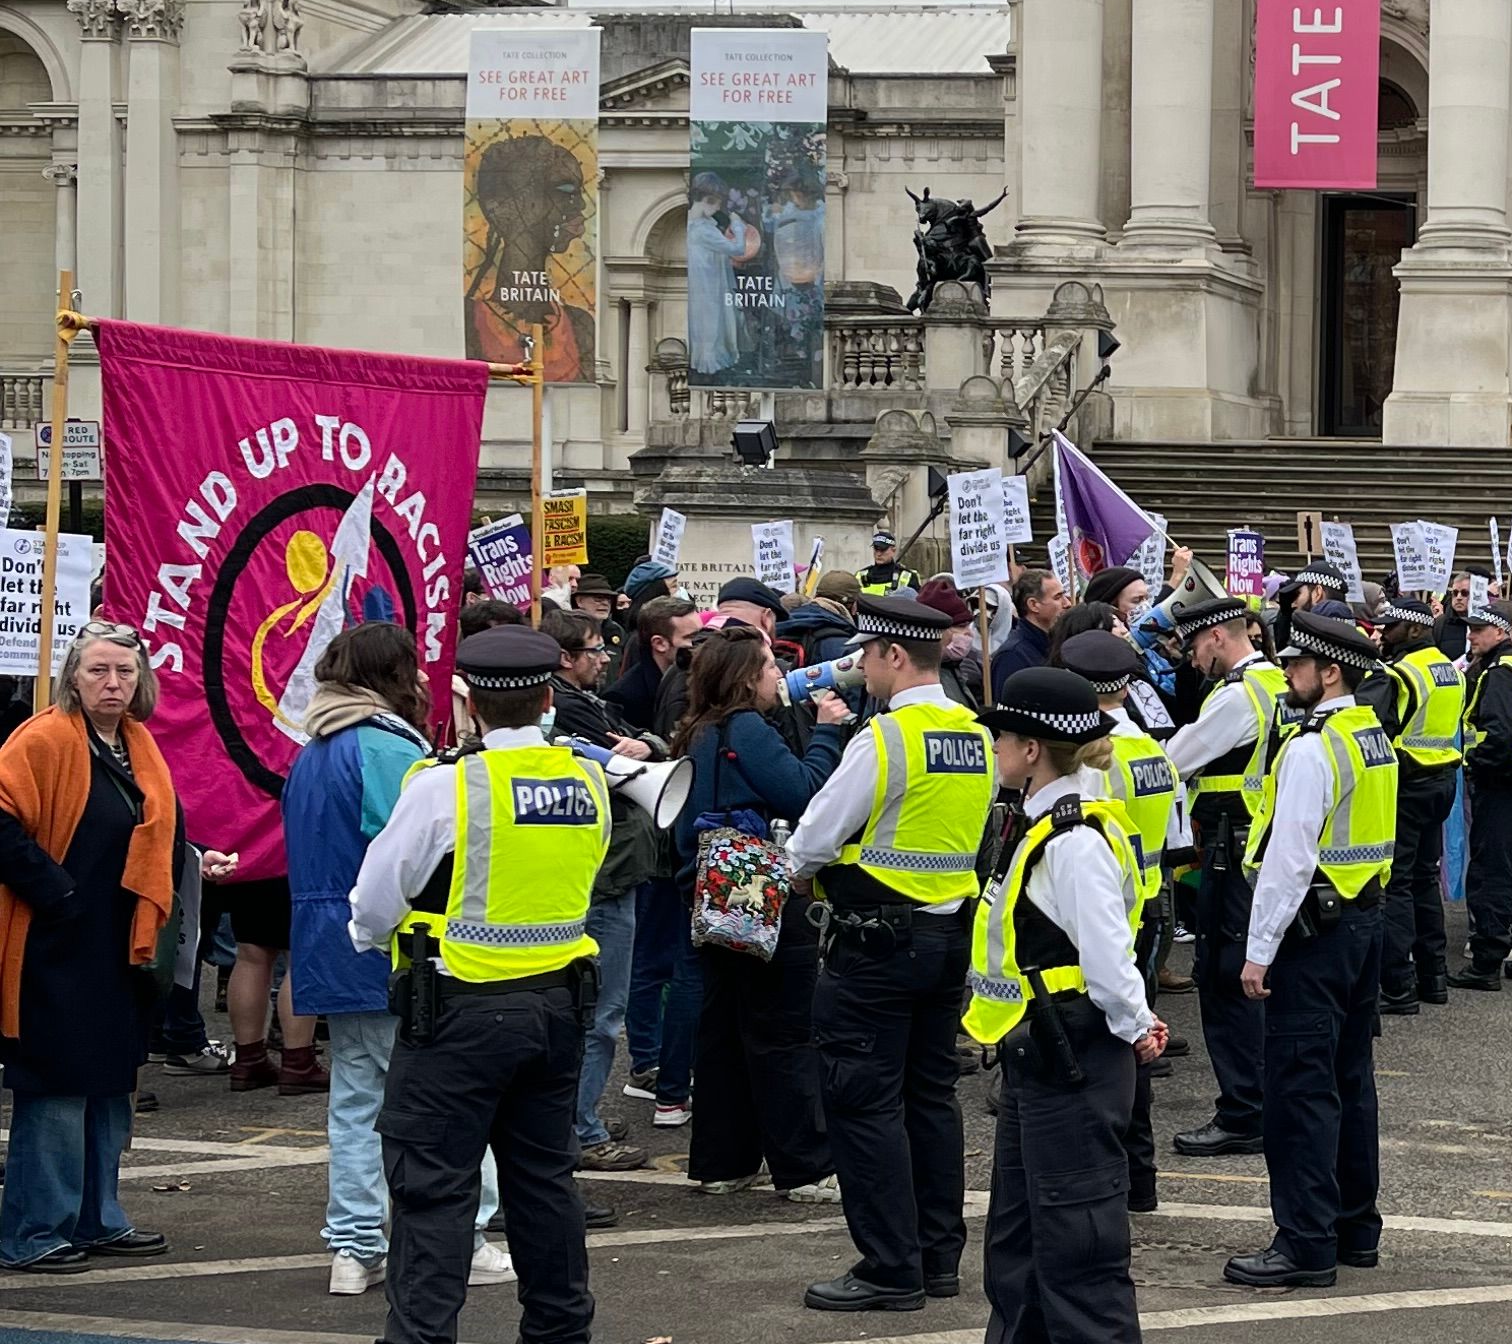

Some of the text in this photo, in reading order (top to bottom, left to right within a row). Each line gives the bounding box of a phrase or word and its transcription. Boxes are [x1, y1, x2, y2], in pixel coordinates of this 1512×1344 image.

[725, 53, 793, 62] TATE COLLECTION
[479, 70, 589, 84] SEE GREAT ART
[700, 72, 817, 87] SEE GREAT ART
[1290, 7, 1343, 155] TATE
[500, 87, 567, 101] FOR FREE
[723, 89, 793, 104] FOR FREE
[511, 270, 548, 286] TATE
[737, 276, 773, 291] TATE
[500, 287, 561, 303] BRITAIN
[724, 292, 786, 308] BRITAIN
[68, 426, 88, 435] RED
[544, 499, 574, 514] SMASH
[957, 494, 982, 511] Don't
[544, 515, 580, 531] FASCISM
[958, 510, 988, 526] let the
[554, 531, 585, 547] RACISM
[959, 526, 973, 541] far
[975, 523, 996, 540] right
[143, 470, 238, 673] STAND
[238, 416, 299, 480] UP
[314, 413, 372, 472] TO
[376, 450, 450, 663] RACISM
[468, 535, 519, 564] Trans
[759, 538, 778, 550] Don't
[960, 540, 1000, 557] divide us
[1228, 533, 1258, 554] Trans
[481, 553, 533, 587] Rights
[1229, 553, 1263, 577] Rights
[1, 576, 24, 594] let
[1229, 573, 1255, 594] Now
[492, 583, 531, 606] Now
[0, 596, 72, 617] far riht
[0, 616, 76, 637] divid us
[930, 737, 986, 768] POLICE
[1134, 761, 1174, 791] POLICE
[516, 785, 596, 816] POLICE
